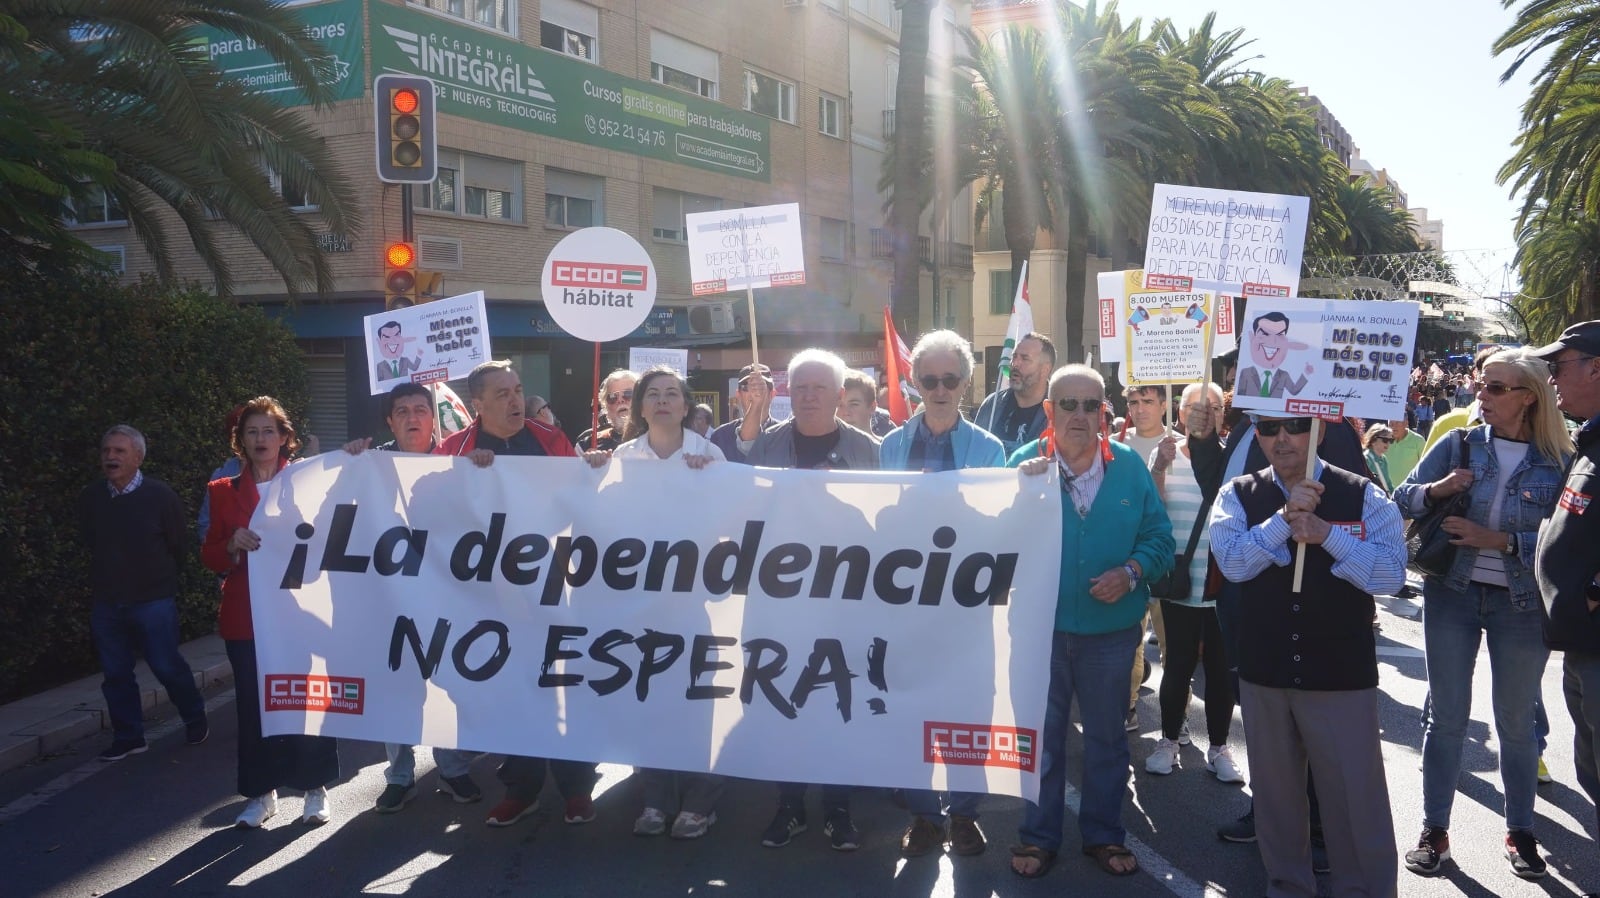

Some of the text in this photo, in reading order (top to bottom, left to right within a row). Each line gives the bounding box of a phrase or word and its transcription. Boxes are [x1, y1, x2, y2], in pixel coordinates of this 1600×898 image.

[209, 38, 243, 60] para
[430, 33, 512, 65] ACADEMIA
[421, 36, 527, 95] INTEGRAL
[434, 85, 557, 124] DE NUEVAS TECNOLOGIAS
[583, 79, 762, 142] Cursos gratis online para trabajadores
[599, 118, 666, 147] 952 21 54 76
[1165, 196, 1291, 223] MORENO BONILLA
[719, 216, 768, 232] BONILLA
[1151, 216, 1177, 233] 603
[1205, 220, 1222, 239] DE
[1224, 222, 1284, 244] ESPERA
[721, 231, 762, 249] CON LA
[1151, 237, 1187, 256] PARA
[705, 246, 781, 266] DEPENDENCIA
[556, 265, 618, 284] CCOO
[712, 266, 727, 281] NO
[729, 264, 742, 277] SE
[772, 273, 796, 281] CCOO
[1148, 258, 1272, 285] DE DEPENDENCIA
[1149, 276, 1181, 286] CCOO
[694, 281, 718, 290] CCOO
[1245, 285, 1278, 296] CCOO
[562, 287, 634, 308] hábitat
[1130, 293, 1204, 304] 8.000 MUERTOS
[429, 315, 474, 332] Miente
[1102, 307, 1110, 336] CCOO
[1218, 304, 1226, 333] CCOO
[1320, 314, 1356, 323] JUANMA
[1370, 316, 1408, 326] BONILLA
[426, 325, 480, 344] más que
[1332, 327, 1403, 348] Miente
[435, 338, 473, 353] habla
[1322, 345, 1408, 367] más que
[1332, 362, 1393, 382] habla
[1288, 401, 1329, 414] CCOO
[279, 503, 1019, 608] ¡La dependencia
[388, 615, 888, 724] NO ESPERA!
[270, 679, 342, 699] CCOO
[270, 697, 358, 711] Pensionistas Málaga
[930, 727, 1013, 752] CCOO
[930, 747, 1031, 767] Pensionistas Málaga
